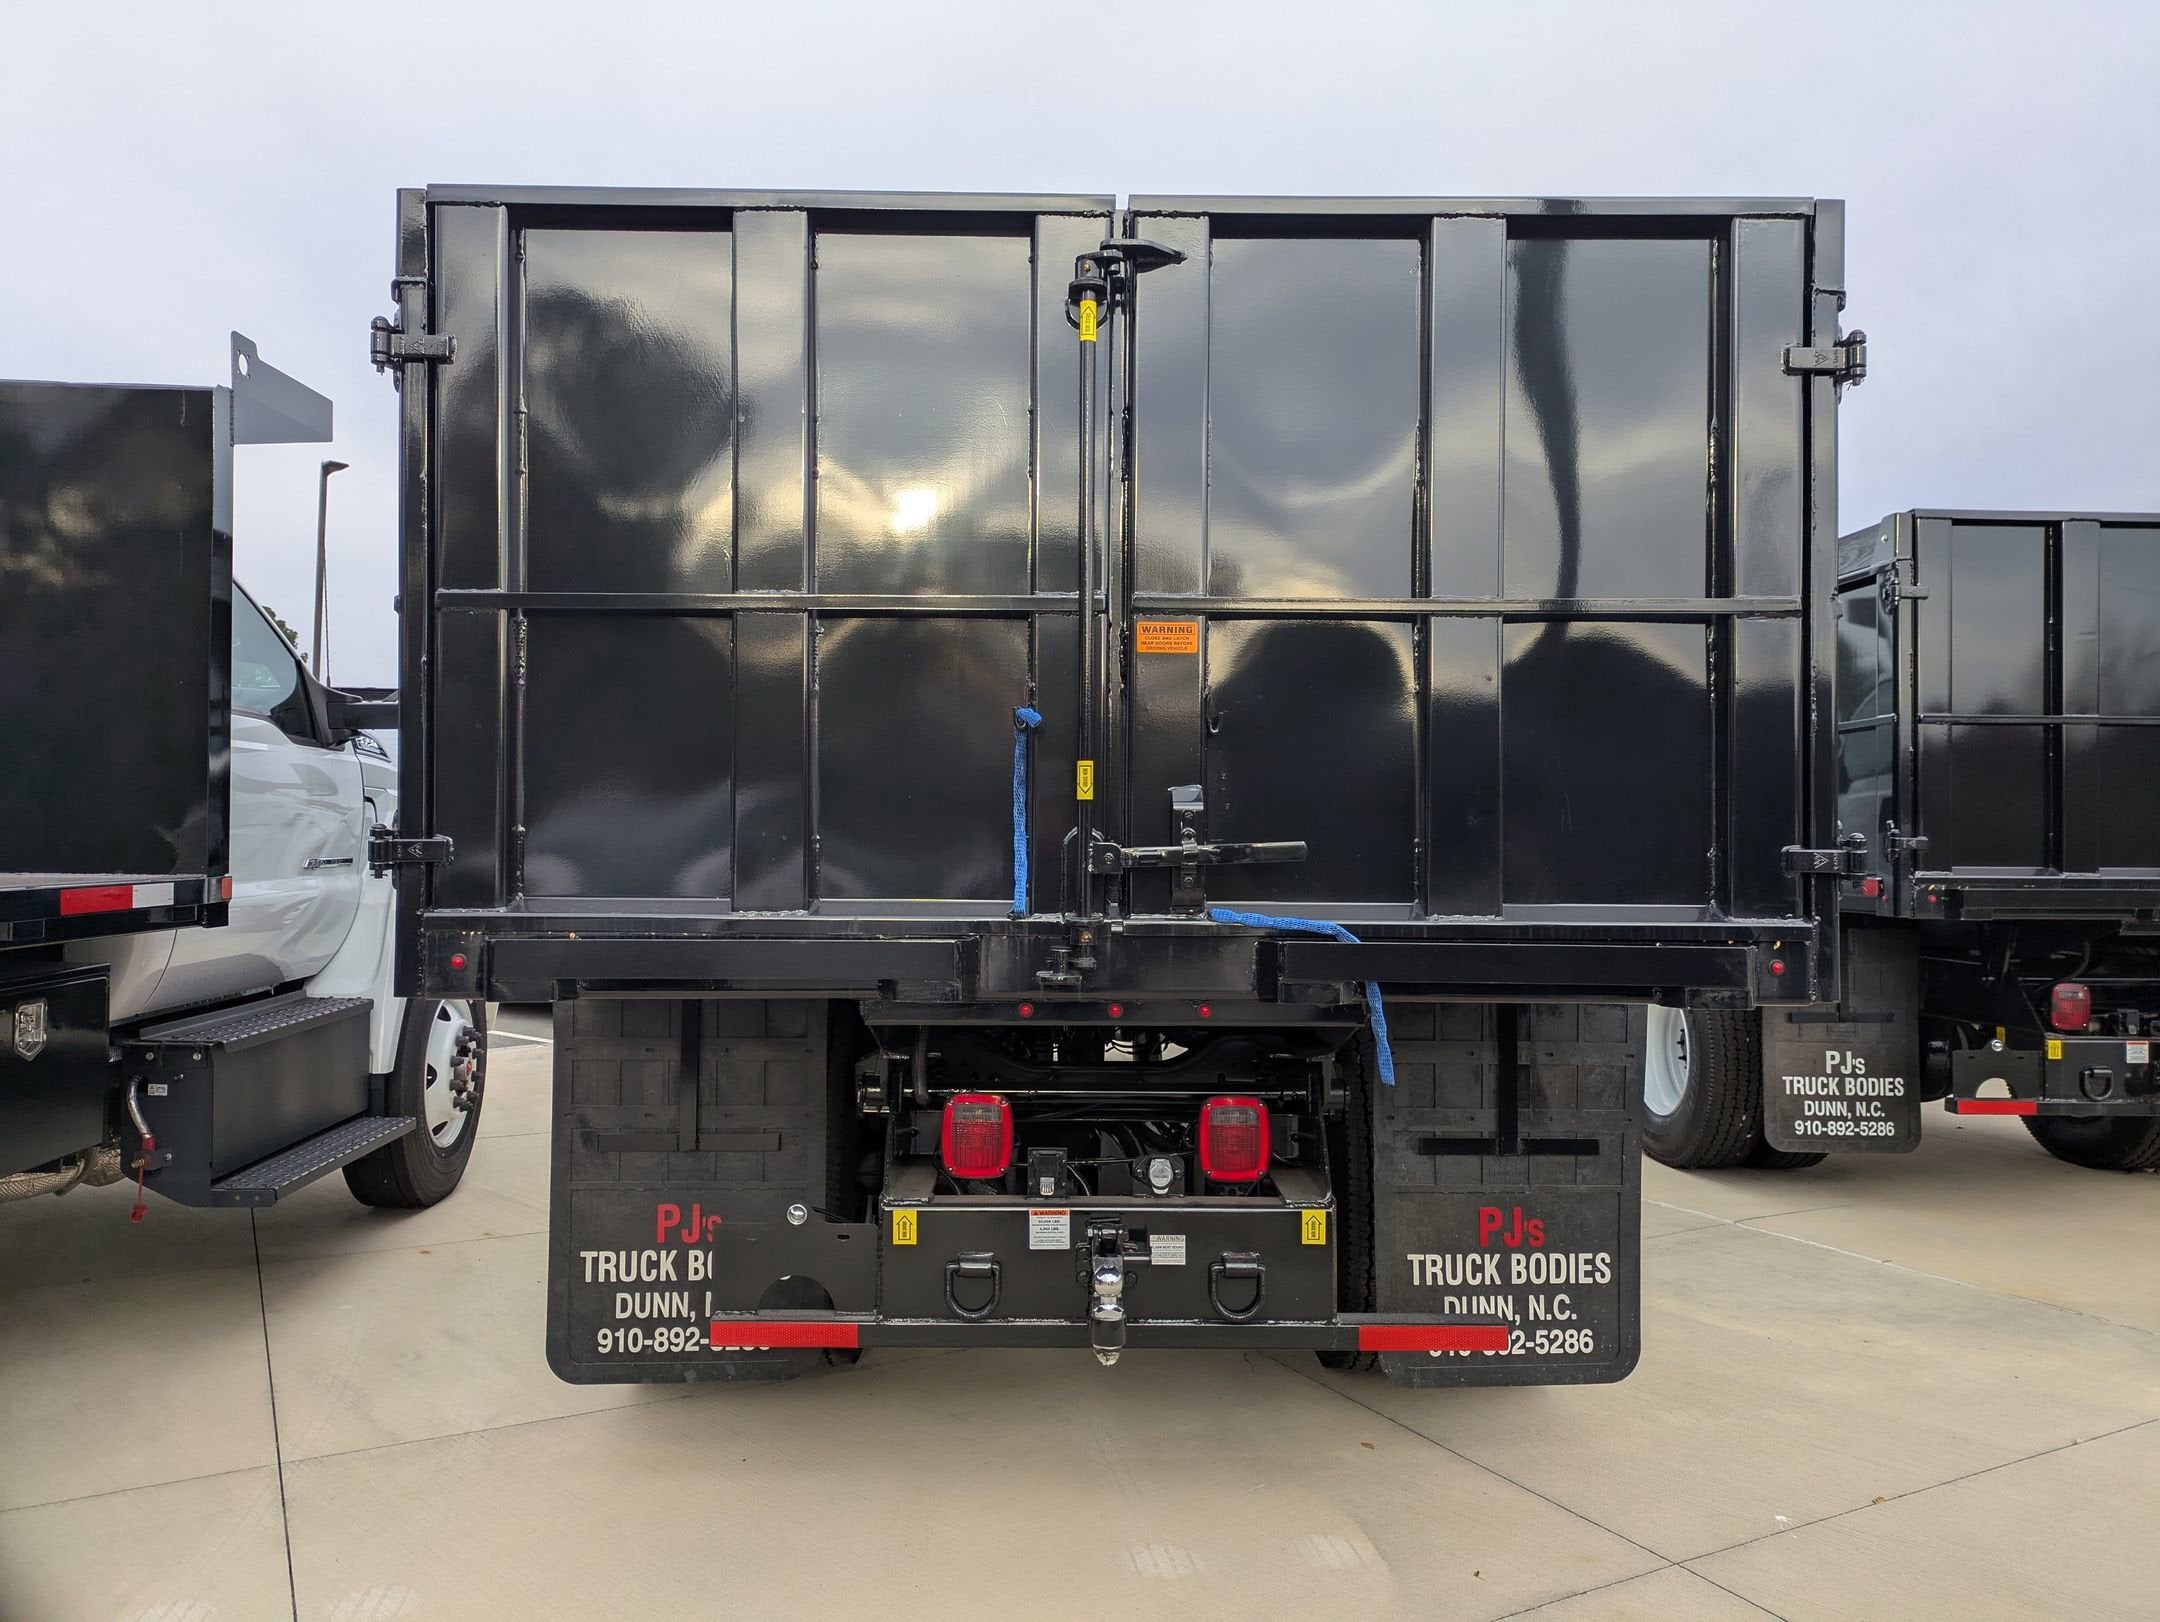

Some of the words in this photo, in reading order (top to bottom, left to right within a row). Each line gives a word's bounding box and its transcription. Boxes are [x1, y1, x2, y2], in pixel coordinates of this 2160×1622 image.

[1141, 626, 1193, 634] WARNING
[1782, 1076, 1840, 1095] TRUCK
[1845, 1076, 1904, 1097] BODIES
[1804, 1100, 1852, 1119] DUNN,
[1856, 1101, 1886, 1117] N.C.
[1794, 1120, 1894, 1136] 910-892-5286
[1478, 1206, 1546, 1249] PJ's
[580, 1250, 678, 1282] TRUCK
[1407, 1253, 1502, 1286] TRUCK
[1511, 1252, 1612, 1284] BODIES
[616, 1291, 696, 1322] DUNN,
[1528, 1293, 1578, 1321] N.C.
[597, 1326, 770, 1354] 910-892-
